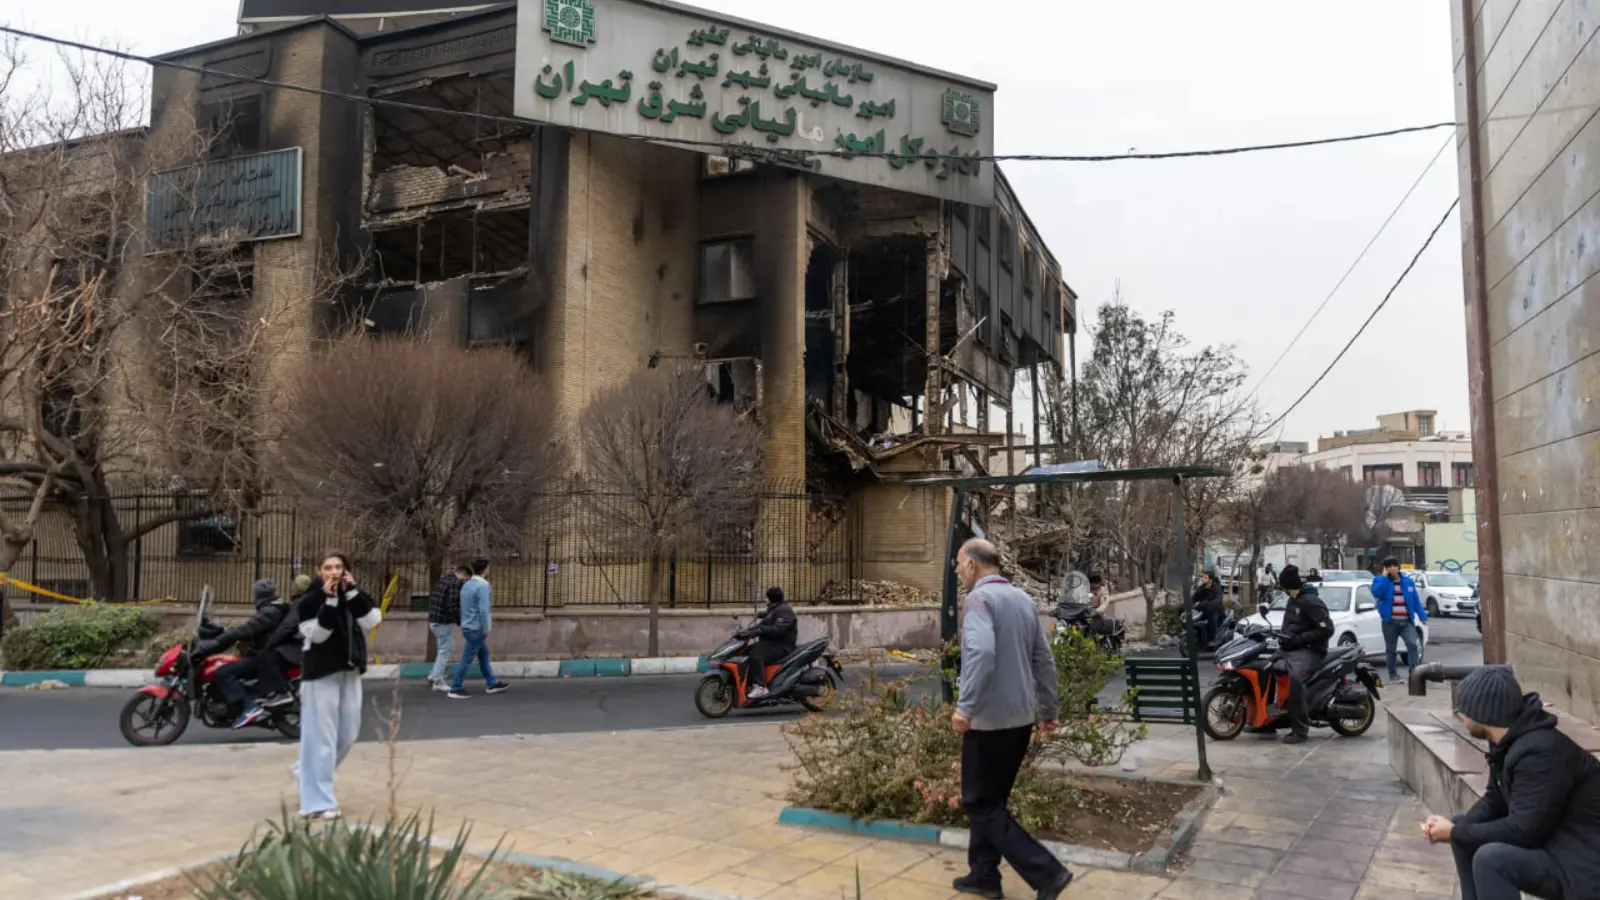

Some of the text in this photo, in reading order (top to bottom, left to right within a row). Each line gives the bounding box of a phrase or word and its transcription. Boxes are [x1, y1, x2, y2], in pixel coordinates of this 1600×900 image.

[687, 25, 874, 83] سازمان امور مالیاتی کشور
[534, 60, 634, 107] تهران
[638, 81, 707, 123] شرق
[652, 46, 896, 120] امور مالیاتی شهر تهران
[889, 134, 924, 169] کل
